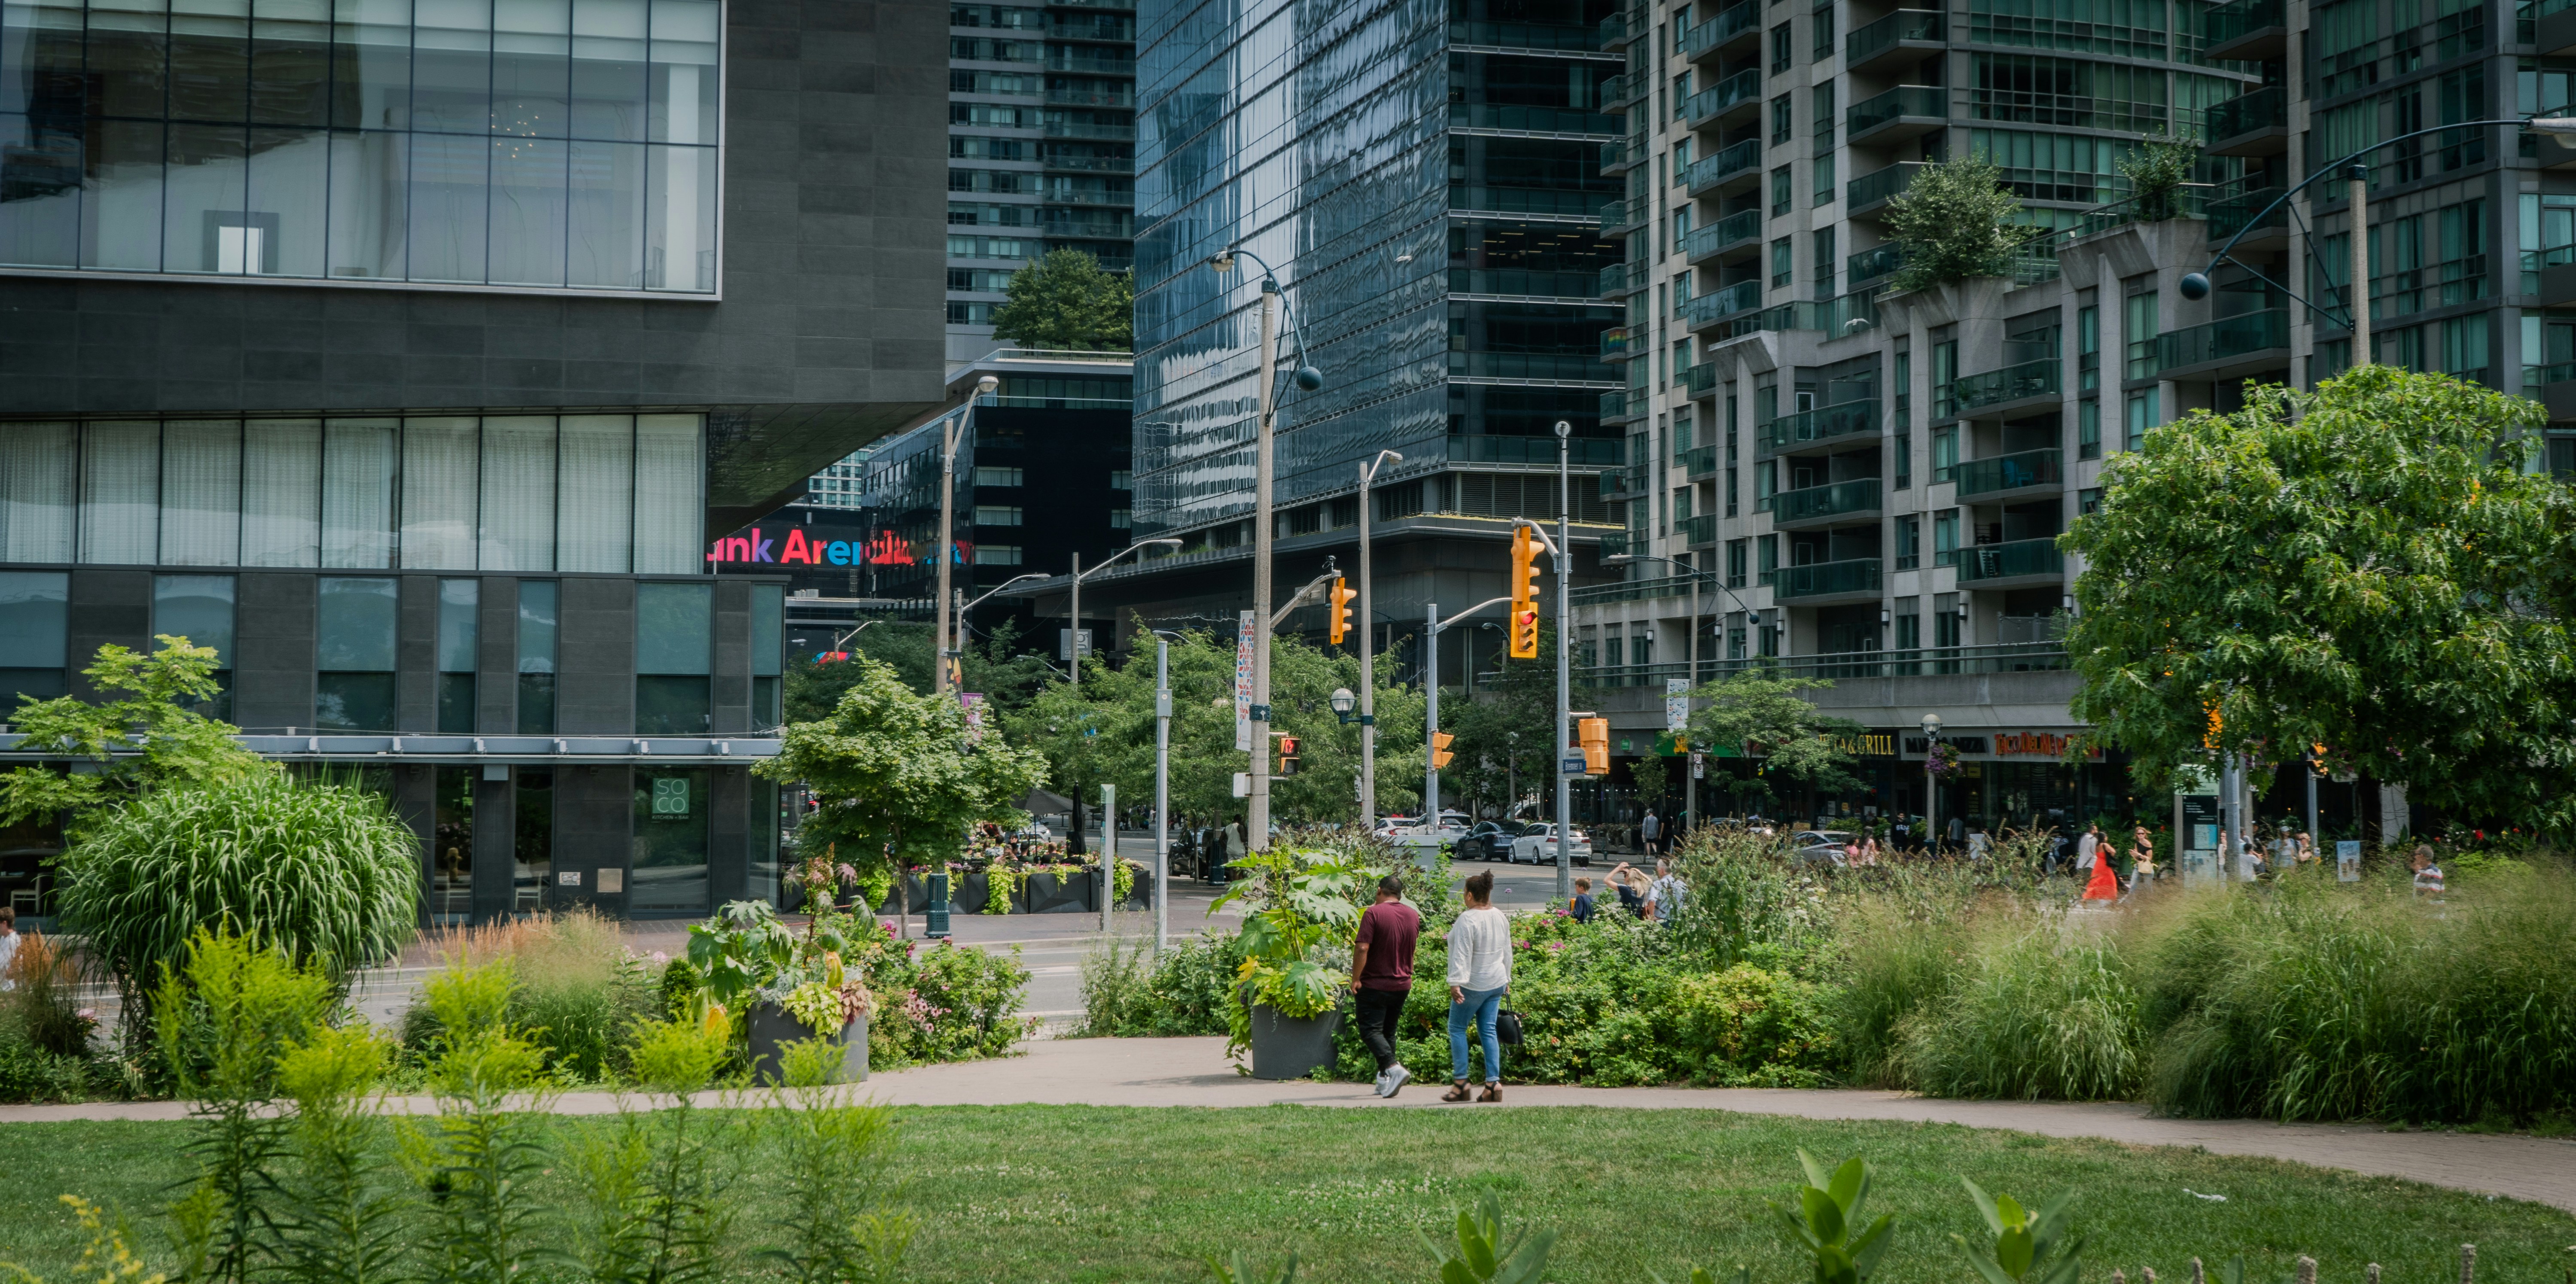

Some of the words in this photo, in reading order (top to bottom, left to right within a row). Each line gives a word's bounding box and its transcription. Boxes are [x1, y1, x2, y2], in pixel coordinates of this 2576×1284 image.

[1858, 735, 1894, 755] GRILL
[1565, 762, 1578, 770] Bremner
[657, 779, 686, 794] SO
[657, 797, 686, 812] CO
